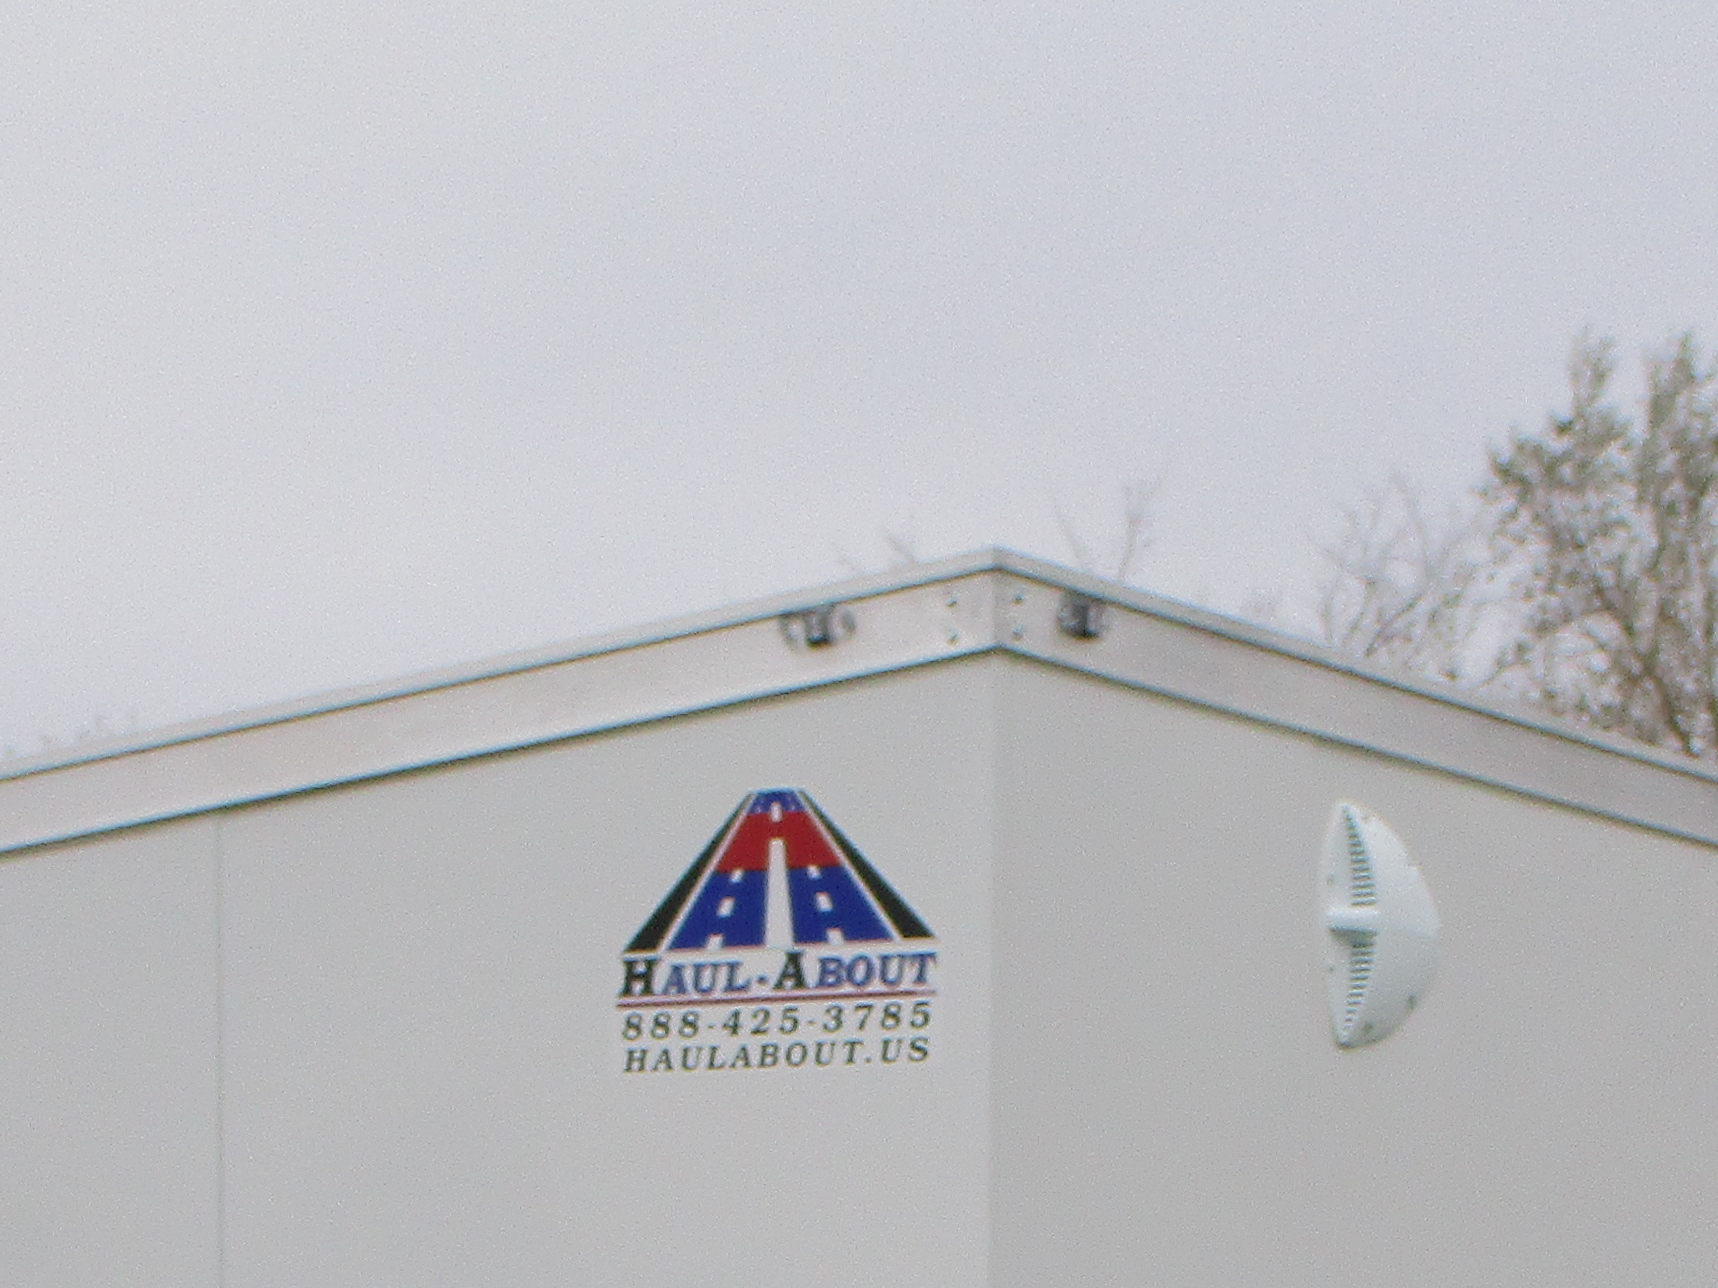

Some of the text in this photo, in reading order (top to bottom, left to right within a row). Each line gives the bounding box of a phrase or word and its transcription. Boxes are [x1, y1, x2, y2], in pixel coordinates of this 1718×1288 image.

[618, 951, 937, 997] HAUL-ABOUT
[621, 1001, 932, 1040] 888-425-3785
[623, 1036, 931, 1073] HAULABOUT.US
